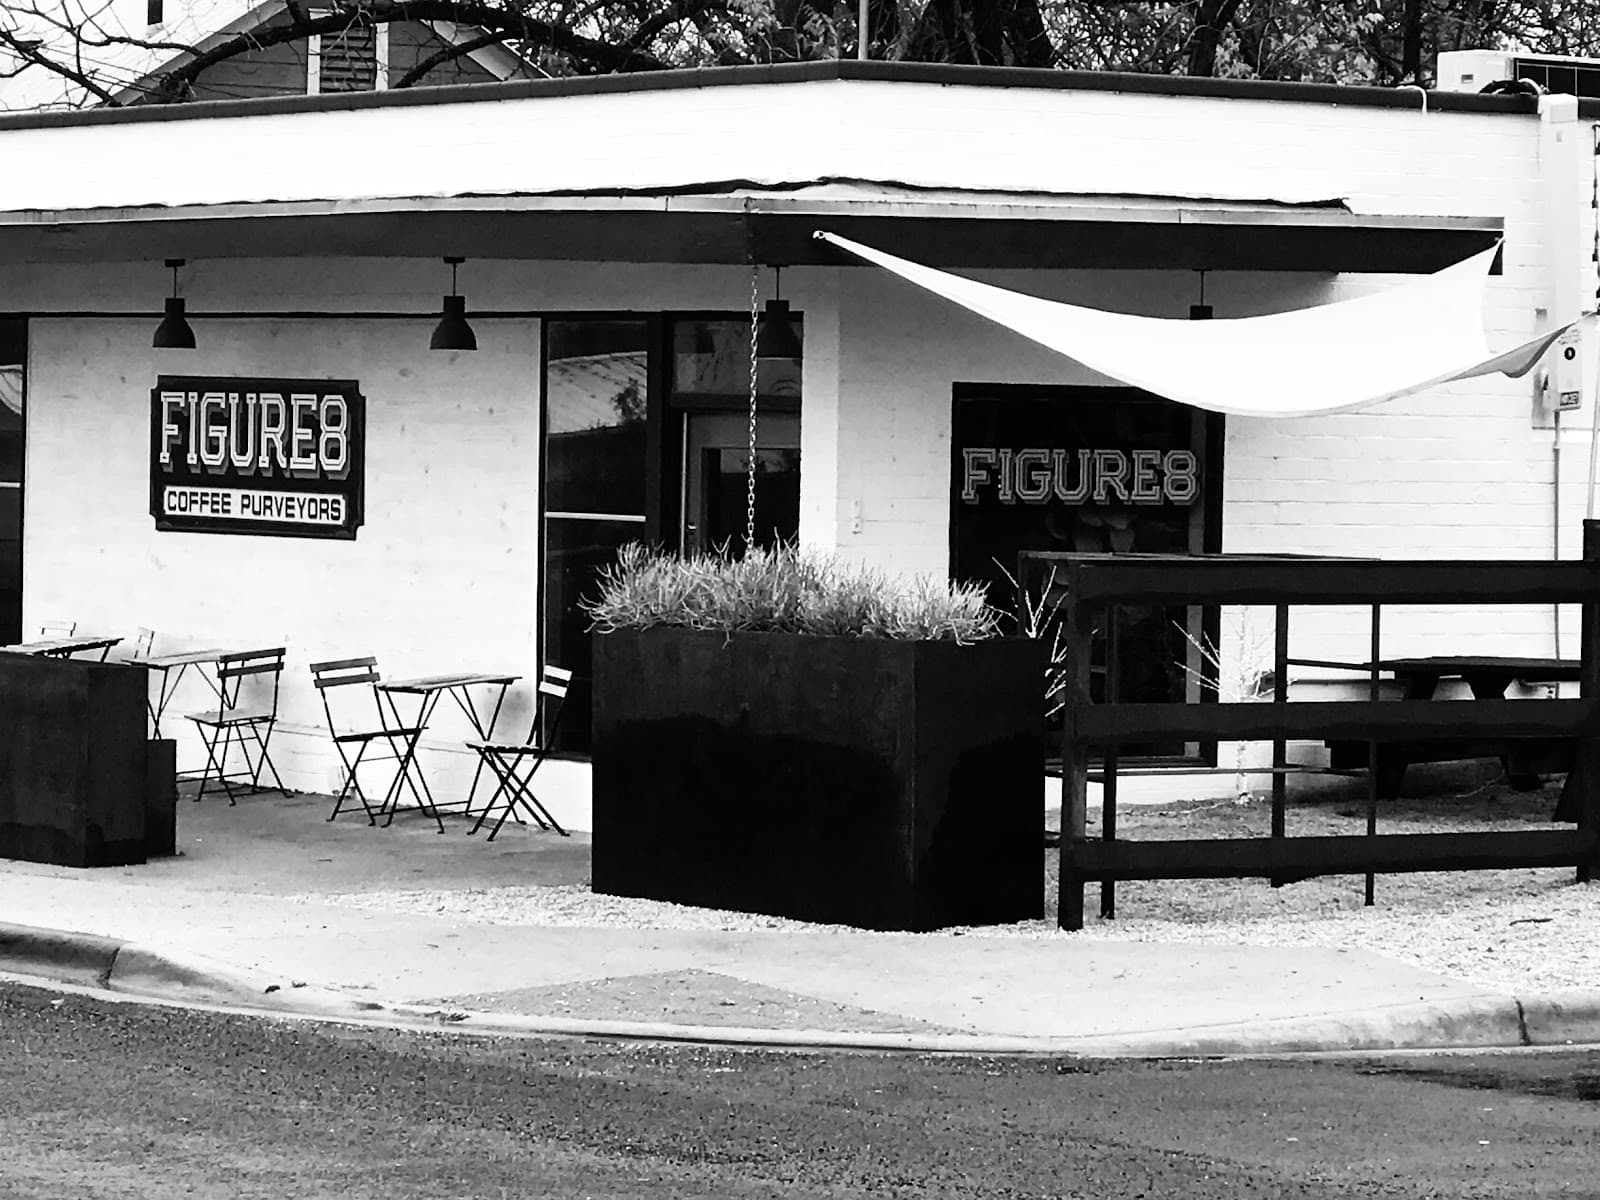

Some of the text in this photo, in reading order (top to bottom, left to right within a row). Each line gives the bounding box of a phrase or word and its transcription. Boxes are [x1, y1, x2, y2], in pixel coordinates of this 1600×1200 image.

[159, 391, 350, 479] FIGURE8
[962, 448, 1199, 505] FIGURE8
[167, 491, 341, 520] COFFEE PURVEYORS
